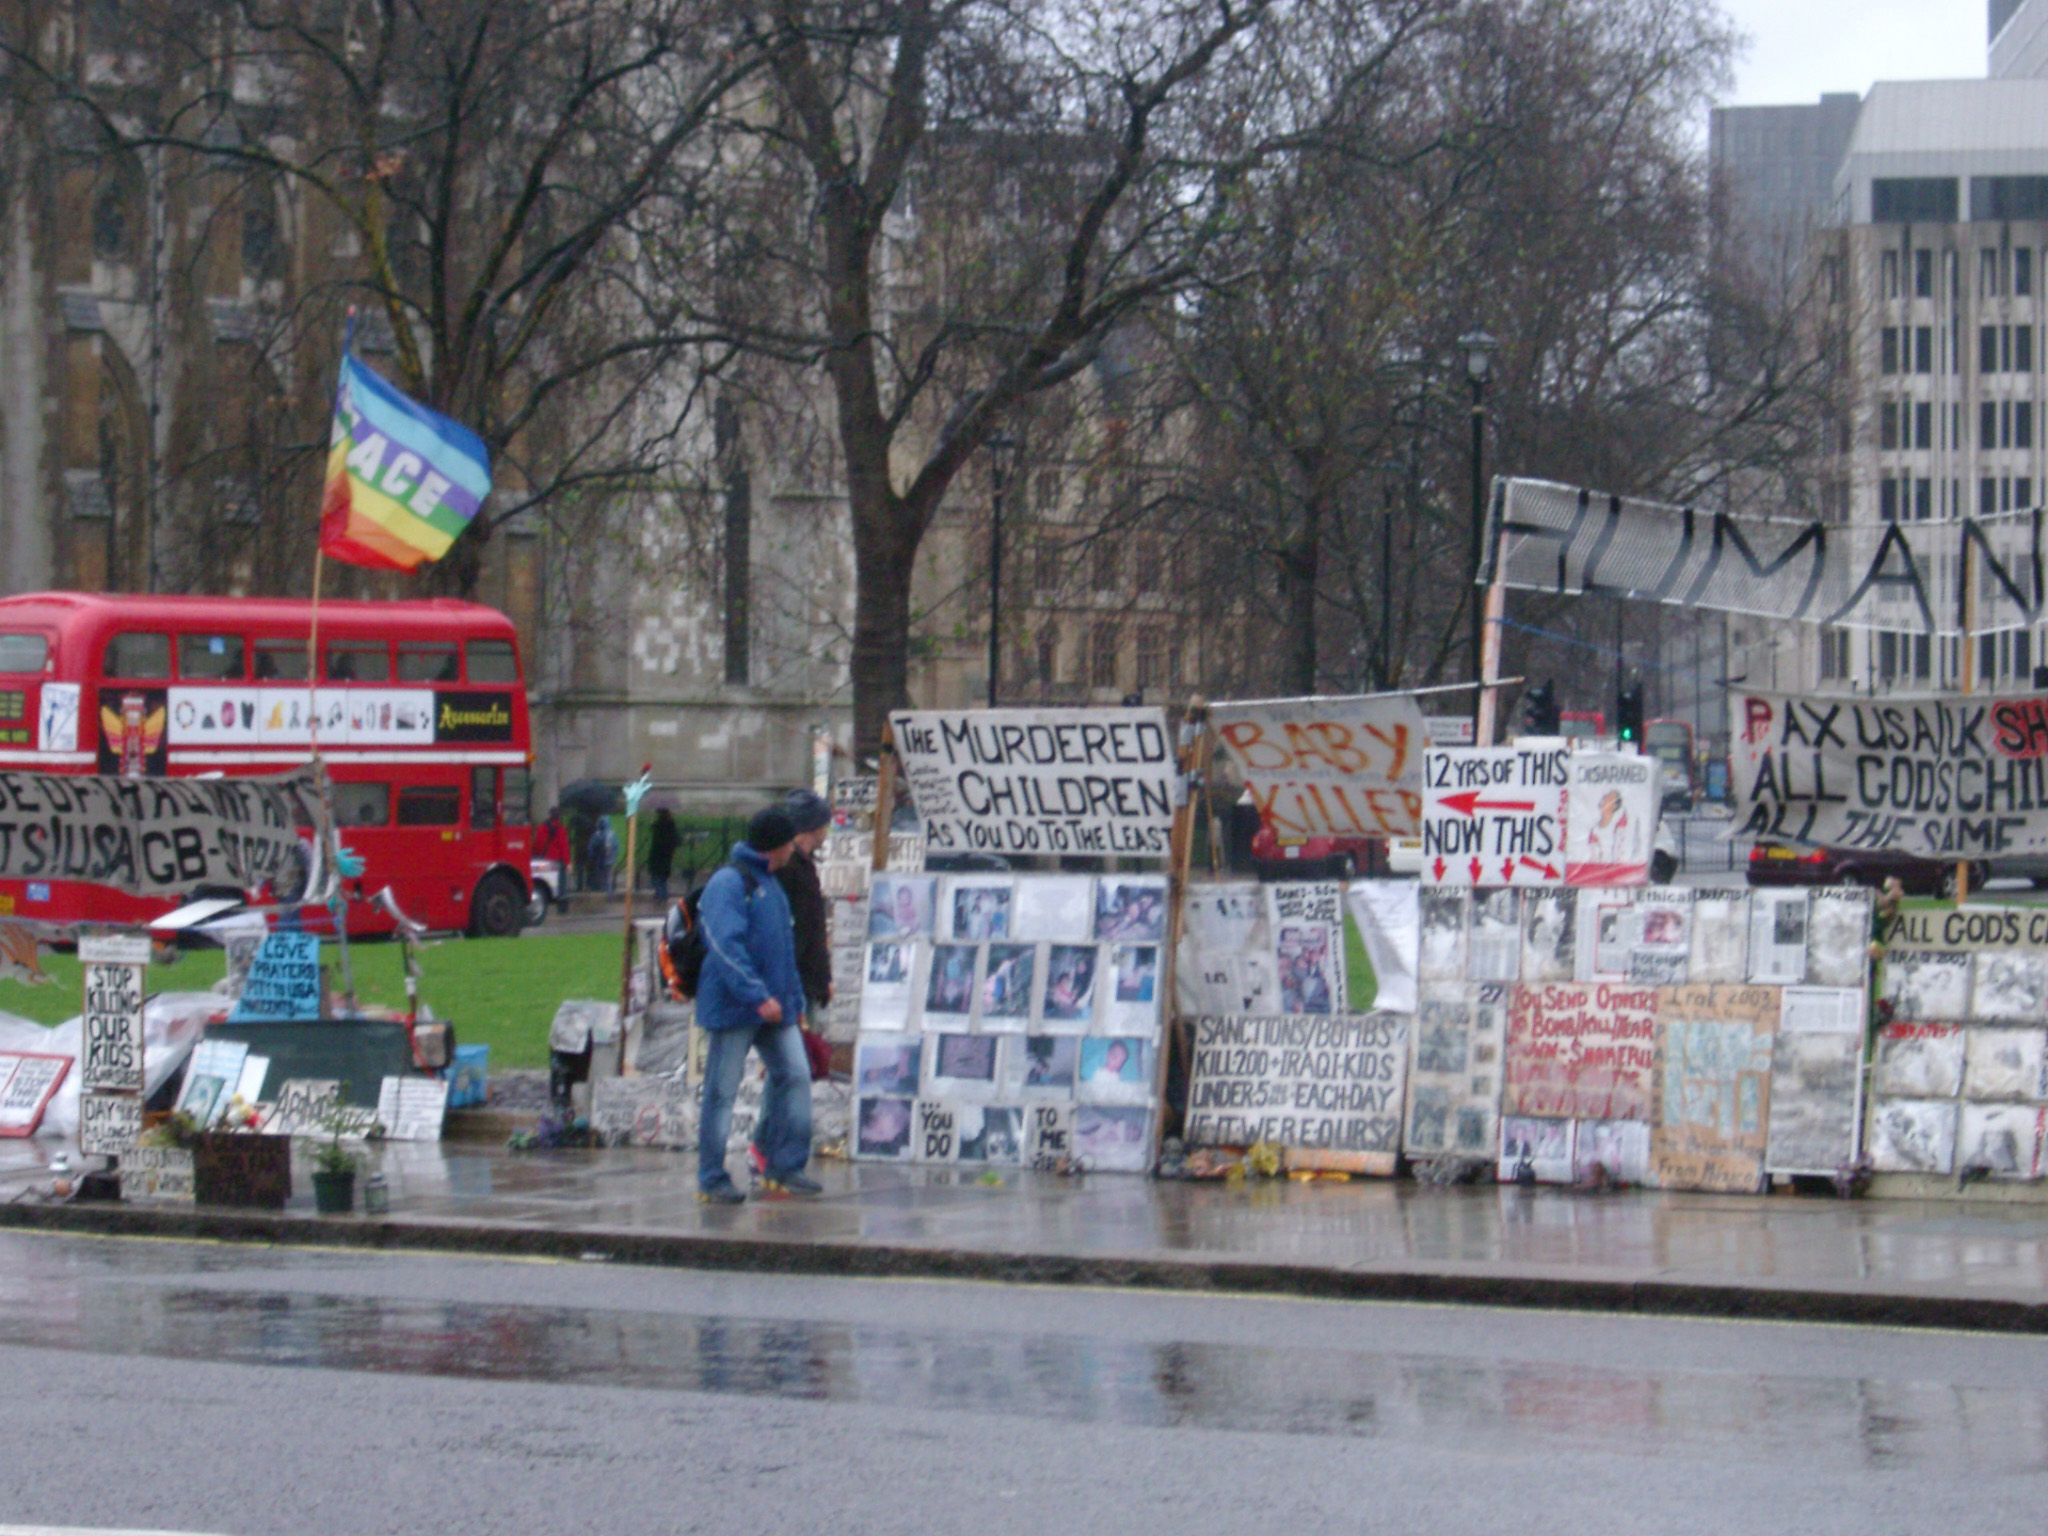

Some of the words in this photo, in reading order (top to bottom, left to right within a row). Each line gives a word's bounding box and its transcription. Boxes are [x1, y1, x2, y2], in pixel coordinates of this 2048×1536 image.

[1742, 698, 1847, 748] PAX
[940, 717, 1166, 765] MURDERED
[1220, 720, 1409, 782] BABY
[1425, 752, 1451, 788] 12
[1454, 758, 1491, 787] YRS
[1493, 758, 1514, 784] OF
[1517, 750, 1570, 785] THIS
[1751, 753, 1847, 802] ALL
[957, 769, 1172, 818] CHILDREN
[956, 819, 1002, 851] YOU
[1008, 821, 1040, 851] DO
[1040, 821, 1068, 850] TO
[1069, 821, 1104, 851] THE
[1110, 820, 1172, 852] LEAST
[1424, 816, 1485, 856] NOW
[1493, 815, 1554, 855] THIS
[1737, 803, 1817, 842] ALL
[1836, 811, 1916, 848] THE
[1888, 914, 1933, 943] ALL
[264, 943, 309, 960] LOVE
[94, 965, 133, 988] STOP
[89, 1015, 132, 1043] OUR
[89, 1041, 133, 1069] KIDS
[85, 1099, 115, 1121] DAY
[922, 1110, 954, 1130] YOU
[1035, 1107, 1059, 1128] TO
[925, 1134, 952, 1159] DO
[1039, 1130, 1067, 1150] ME
